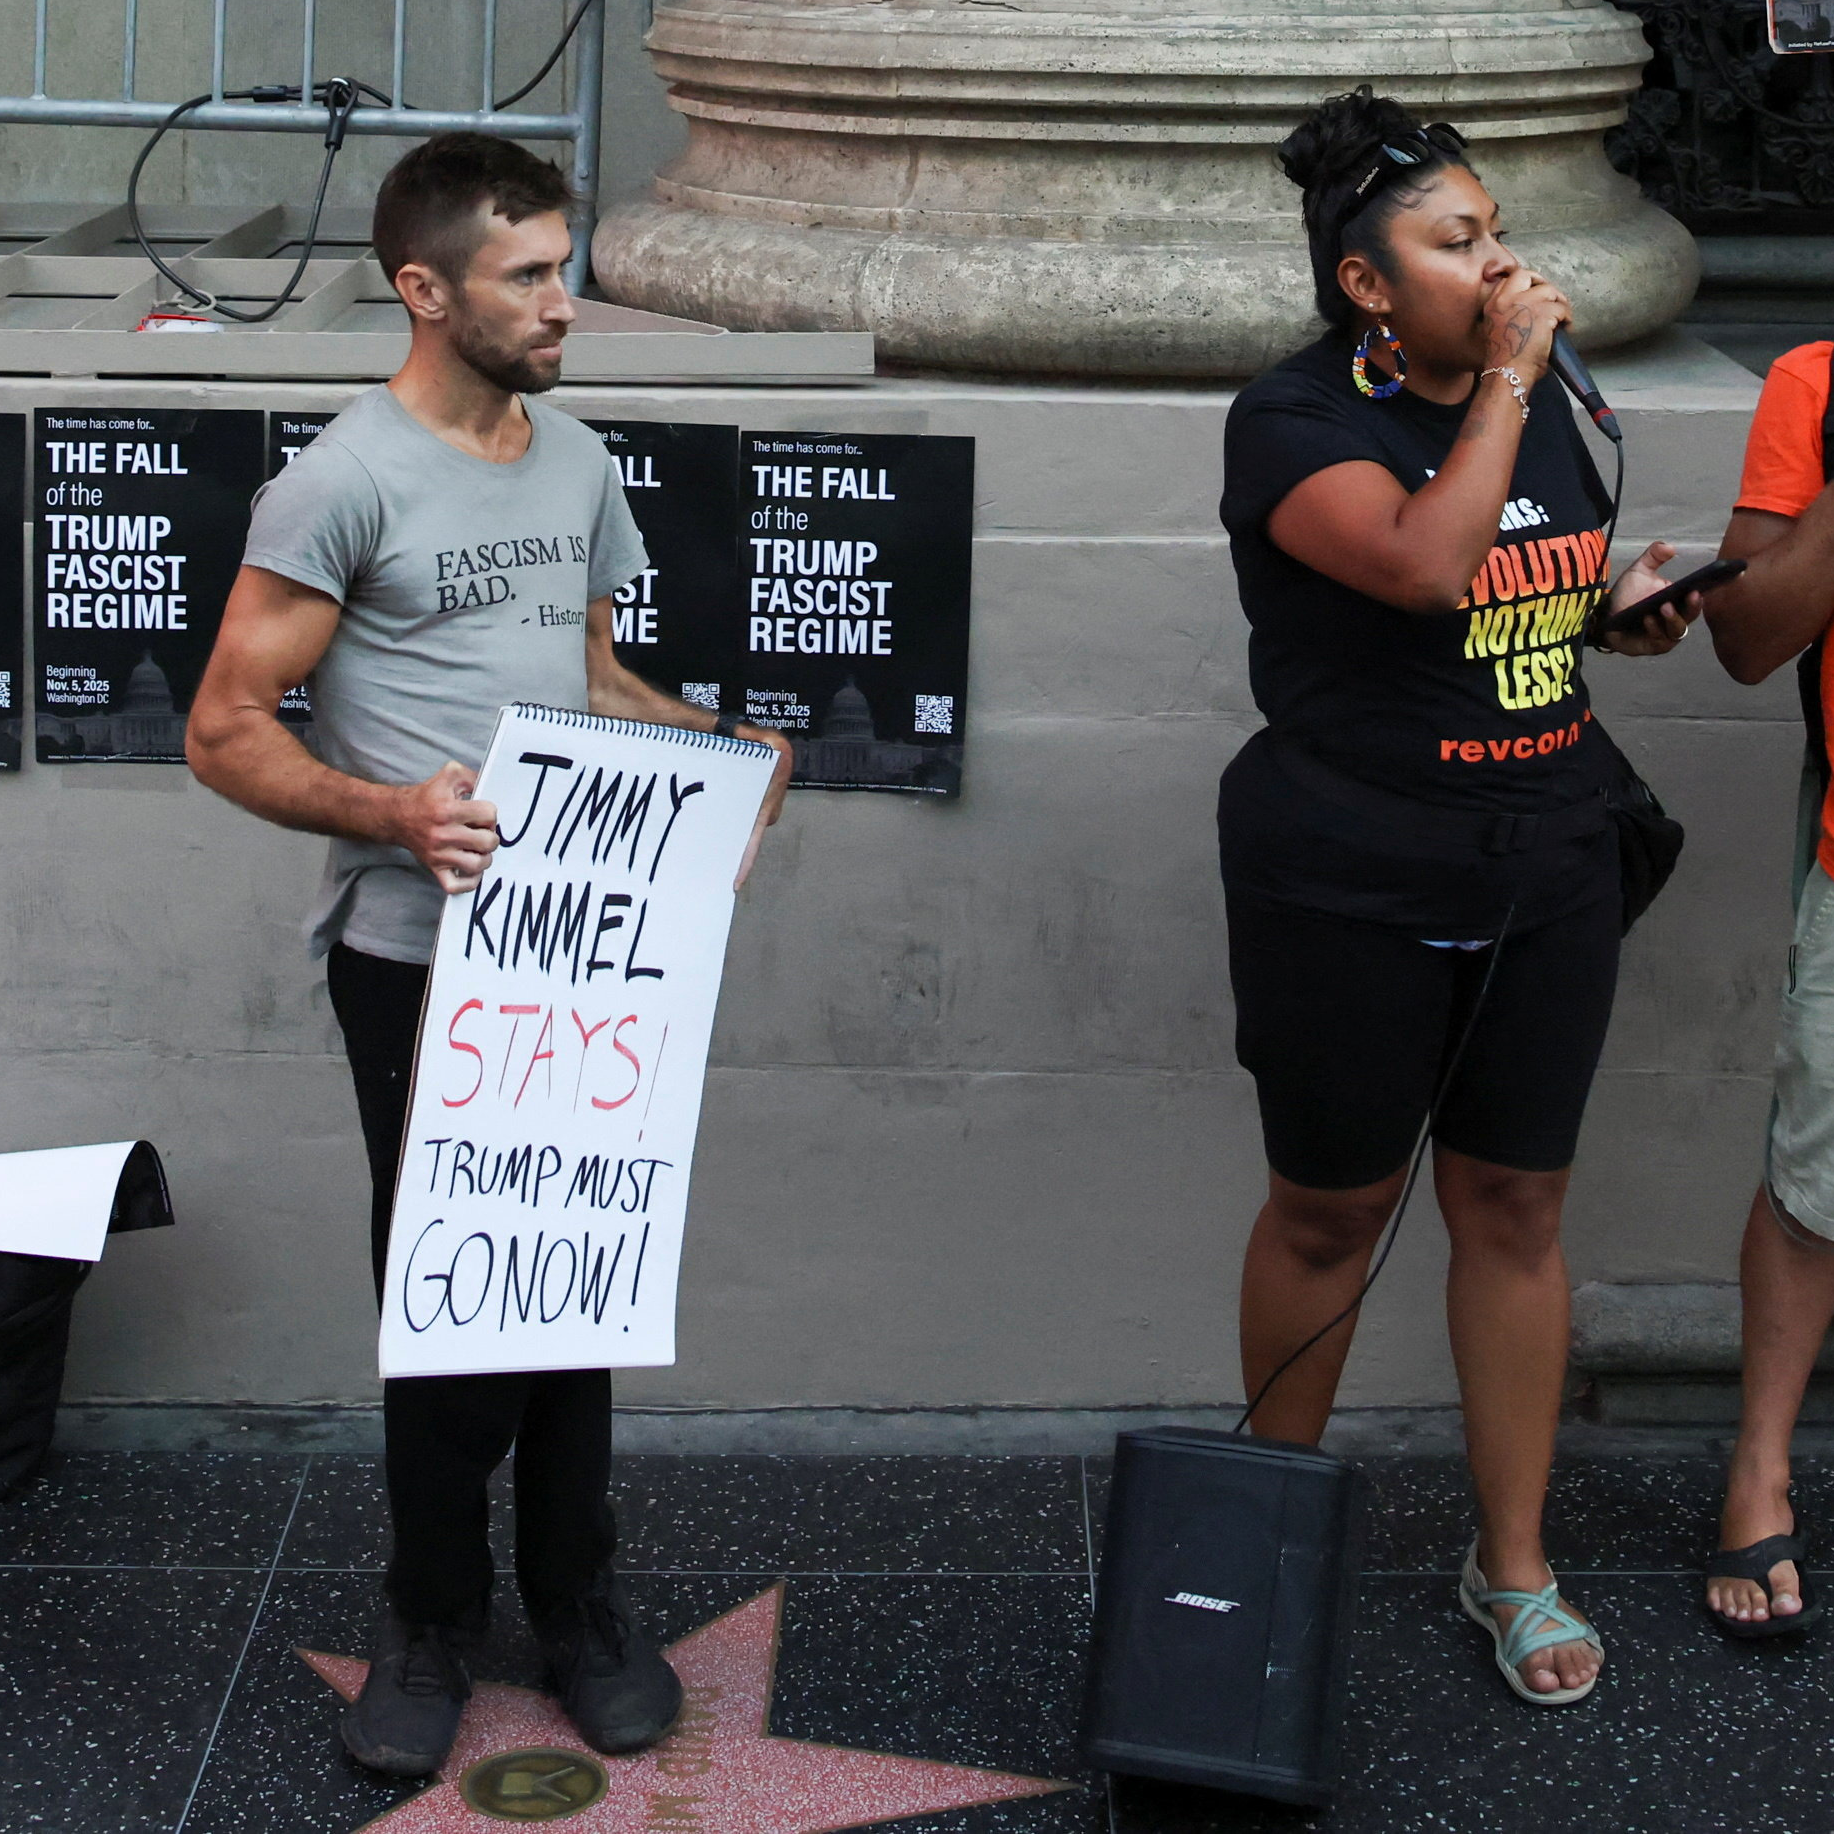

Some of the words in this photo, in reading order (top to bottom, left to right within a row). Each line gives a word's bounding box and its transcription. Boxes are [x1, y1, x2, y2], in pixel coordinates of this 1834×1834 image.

[46, 418, 64, 428] The
[66, 419, 87, 428] time
[90, 418, 106, 429] has
[109, 421, 134, 429] come
[46, 442, 106, 473] THE
[116, 443, 188, 474] FALL
[47, 482, 66, 505] of
[70, 482, 102, 506] the
[752, 466, 812, 497] THE
[823, 468, 895, 500] FALL
[46, 515, 170, 550] TRUMP
[48, 554, 186, 590] FASCIST
[436, 537, 561, 582] FASCISM
[567, 536, 586, 563] IS
[750, 538, 877, 576] TRUMP
[48, 593, 187, 629] REGIME
[437, 575, 516, 614] BAD.
[751, 578, 892, 615] FASCIST
[750, 617, 891, 654] REGIME
[1464, 588, 1601, 659] NOTHIN
[46, 665, 96, 680] Beginning
[47, 679, 69, 690] Nov.
[72, 680, 81, 692] 5,
[84, 680, 109, 691] 2025
[1495, 644, 1574, 709] LESS!
[46, 692, 96, 705] Washington
[97, 694, 108, 703] DC
[495, 751, 704, 883] JIMMY
[465, 881, 665, 988] KIMMEL
[441, 998, 668, 1143] STAYS!
[424, 1137, 562, 1207] TRUMP
[564, 1155, 673, 1213] MUST
[403, 1219, 495, 1332] GO
[499, 1221, 651, 1333] NOW!
[1165, 1592, 1241, 1612] BOSE
